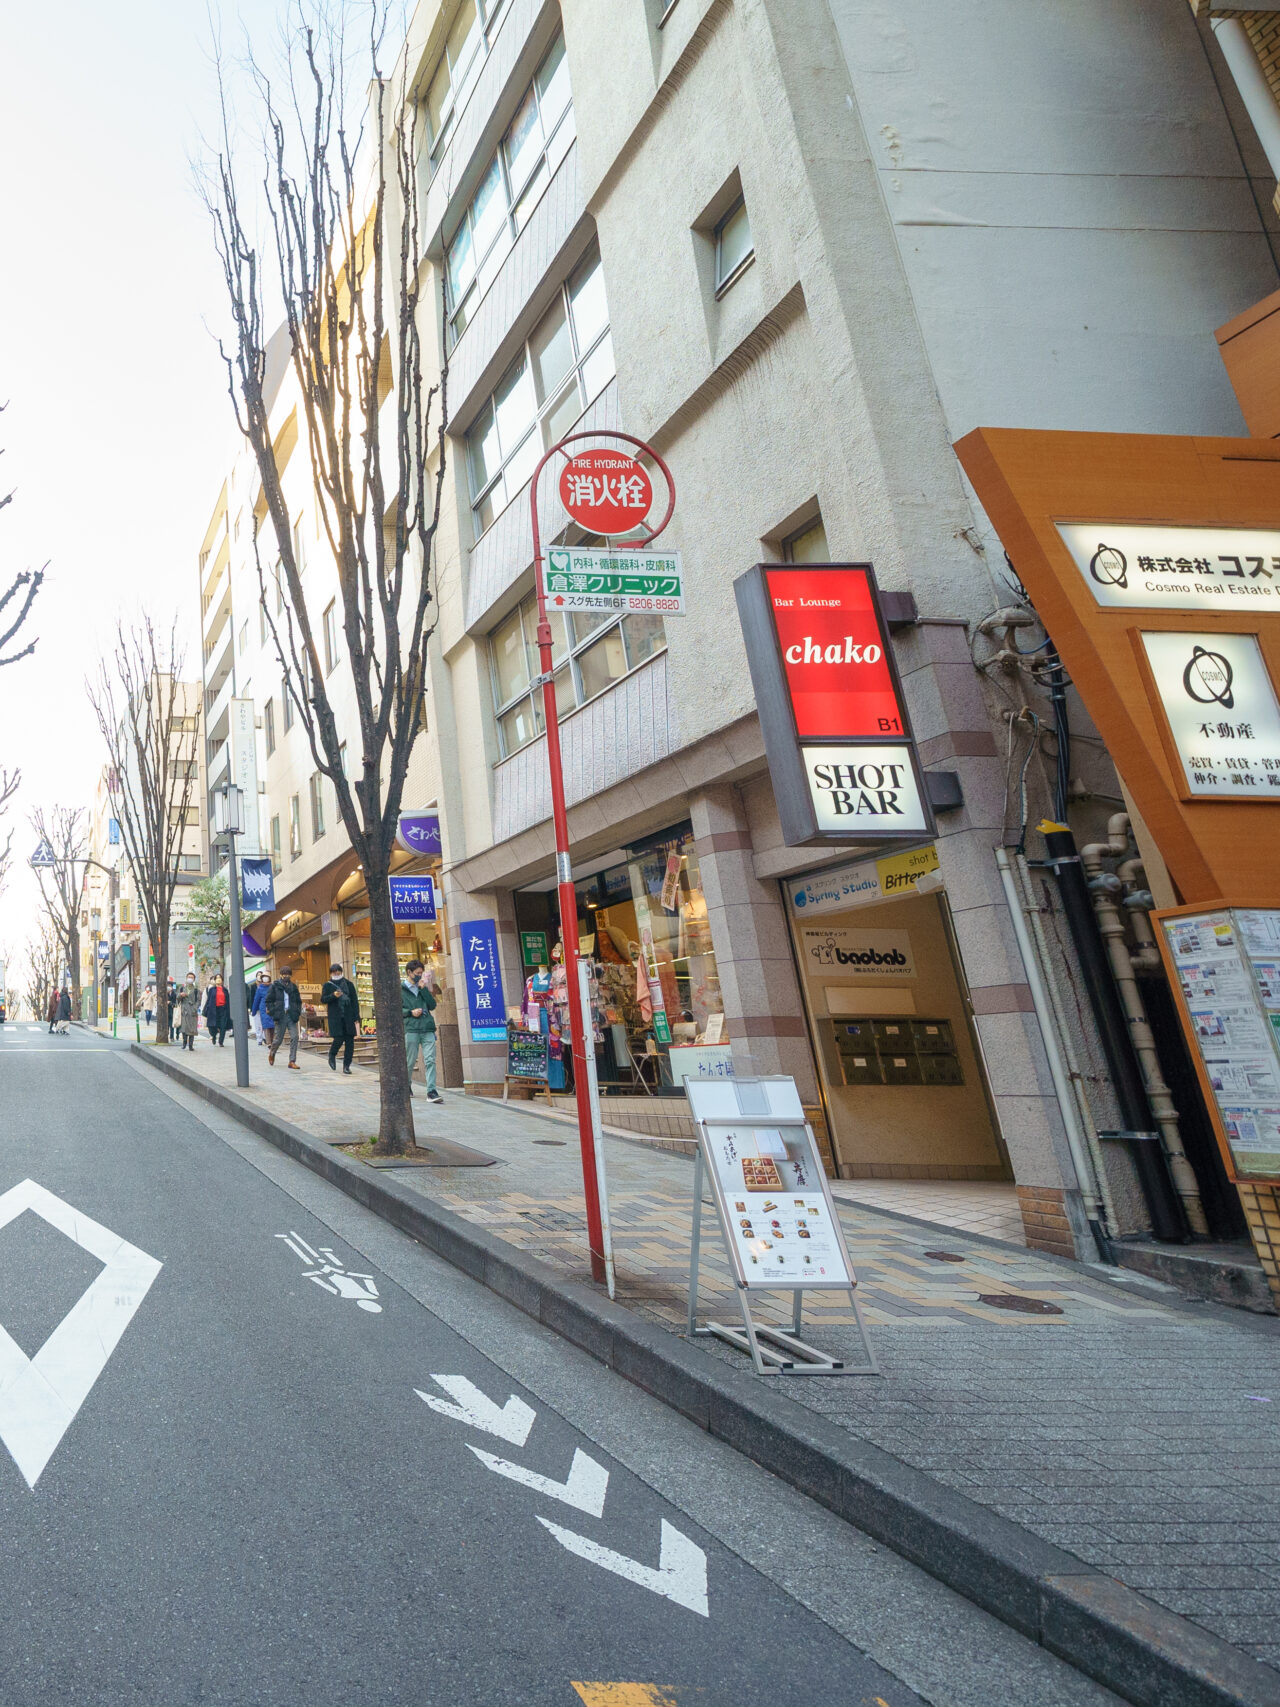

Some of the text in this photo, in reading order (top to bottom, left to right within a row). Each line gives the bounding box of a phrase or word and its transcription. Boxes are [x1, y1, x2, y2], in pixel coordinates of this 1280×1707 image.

[572, 459, 634, 469] FIRE HYDRANT
[566, 474, 646, 507] 消火栓
[1137, 556, 1214, 574] 株式会社
[550, 574, 677, 595] 倉澤クリニック
[1145, 581, 1271, 595] Cosmo Real Estate
[774, 598, 841, 607] Bar Lounge
[786, 636, 881, 664] chako
[878, 718, 899, 731] B1
[1196, 722, 1255, 739] 不動産
[814, 764, 905, 789] SHOT
[829, 791, 904, 815] BAR
[909, 854, 929, 866] shot
[885, 871, 926, 889] Bitter
[394, 891, 430, 903] たんす屋
[808, 879, 878, 904] Spring Studio
[394, 906, 433, 914] TANSU-YA
[835, 948, 906, 965] baobab
[469, 936, 493, 1009] たんす屋
